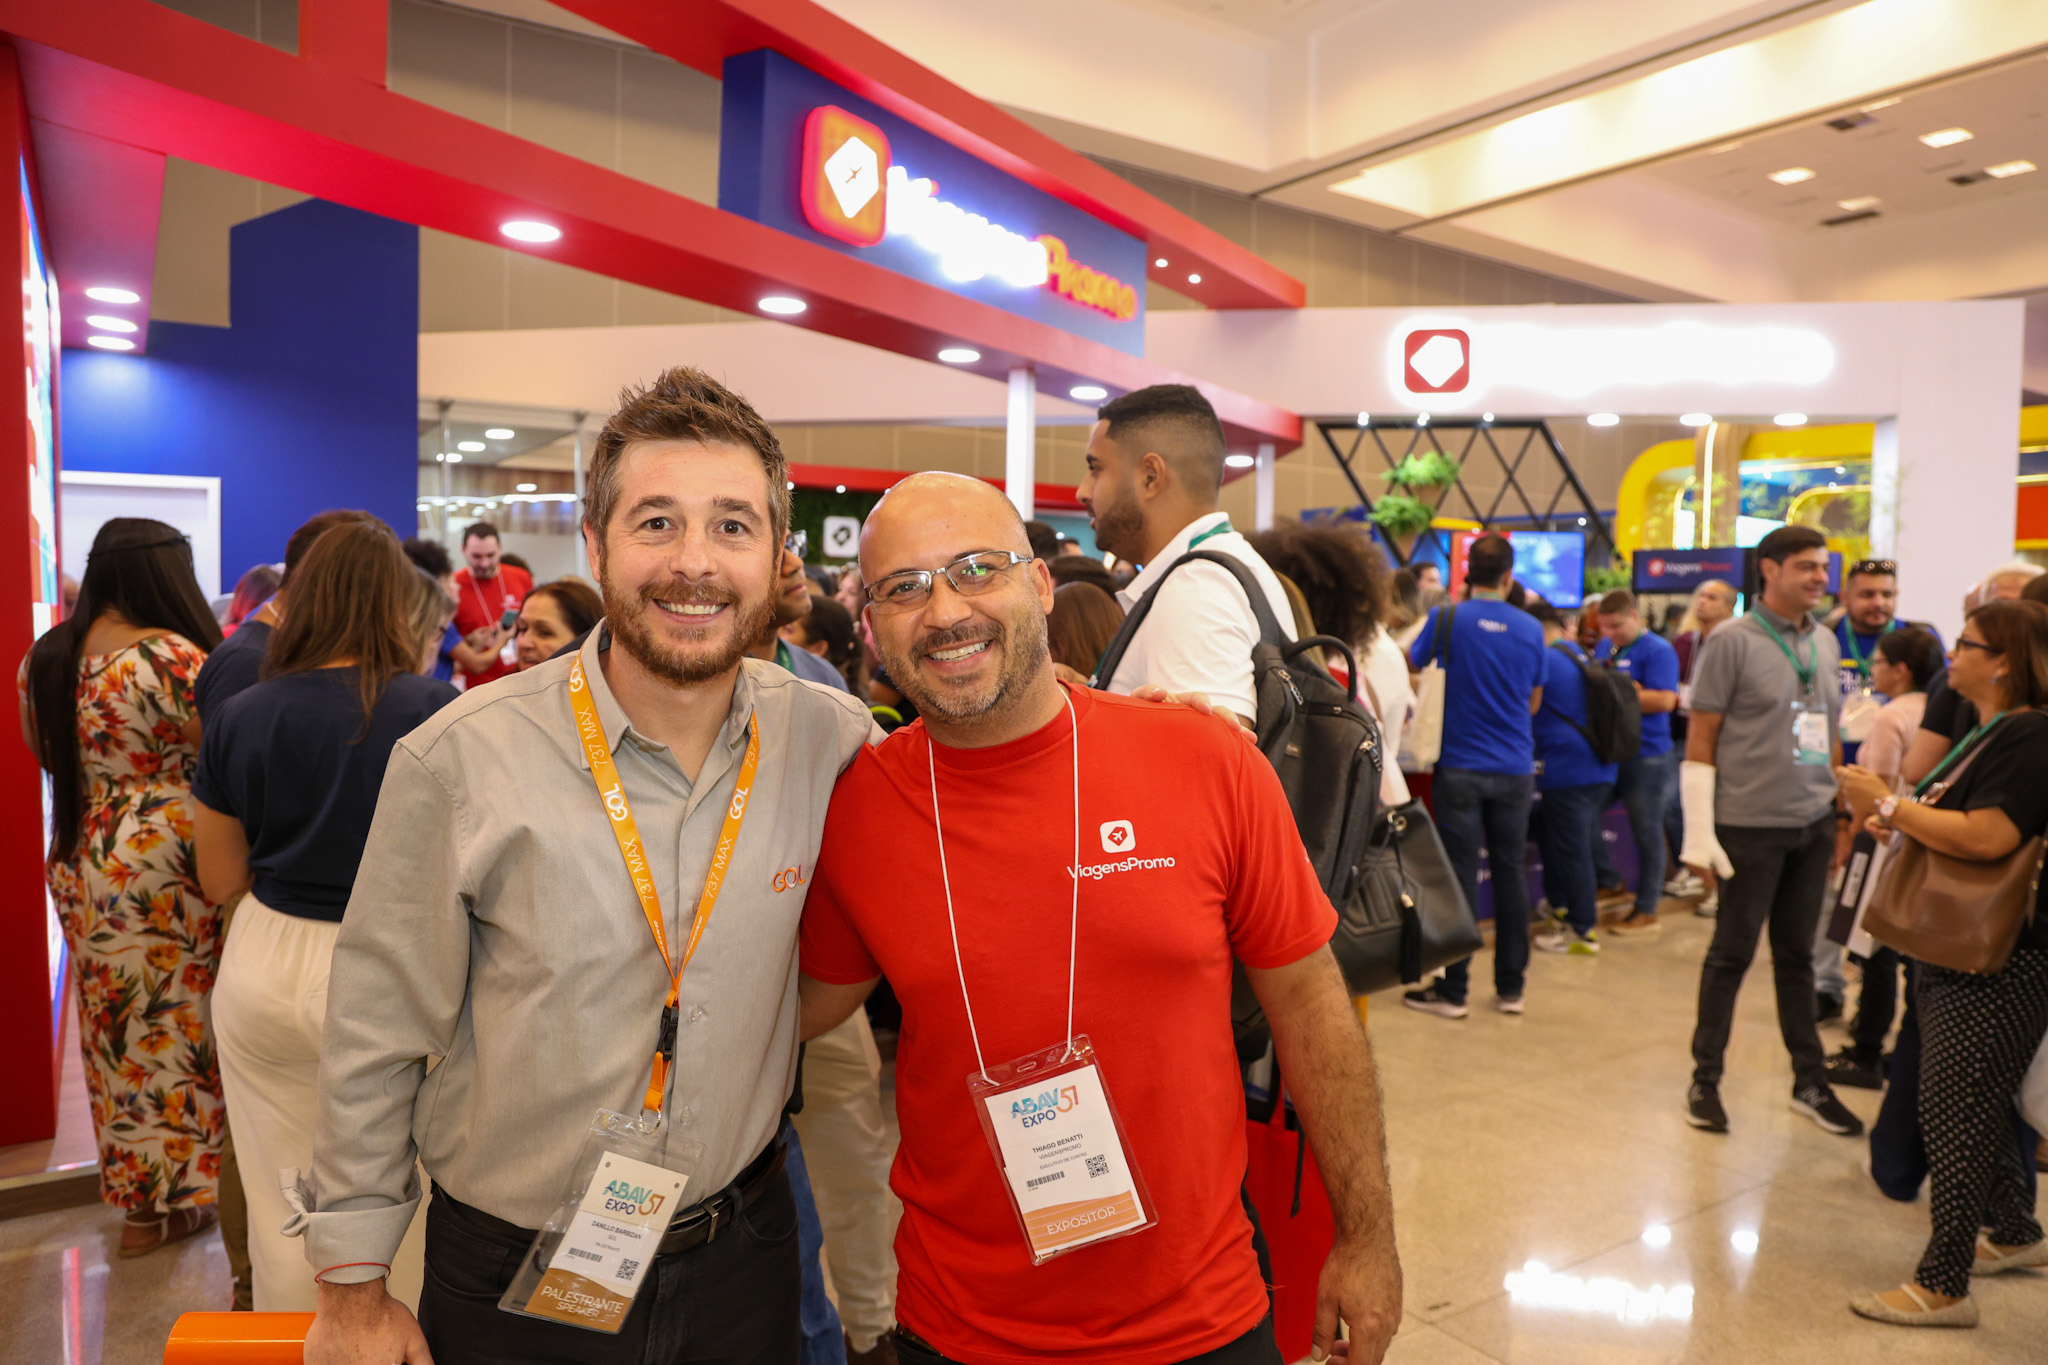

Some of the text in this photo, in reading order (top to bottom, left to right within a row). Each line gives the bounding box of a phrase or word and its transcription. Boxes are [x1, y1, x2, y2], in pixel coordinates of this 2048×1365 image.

[578, 706, 608, 769] 737 MAX
[603, 783, 628, 821] GOL
[730, 786, 748, 819] GOL
[624, 837, 654, 903] 737 MAX
[705, 836, 733, 899] 737 MAX
[772, 864, 806, 892] GOL
[1066, 857, 1176, 880] ViagensPromo
[1011, 1088, 1059, 1119] ABAV
[1022, 1109, 1056, 1128] EXPO
[1032, 1133, 1083, 1154] THIAGO BENATTI
[1039, 1143, 1082, 1160] VIAGENSPROMO
[602, 1180, 653, 1205] ABAV
[605, 1198, 636, 1215] EXPO
[1046, 1206, 1117, 1235] EXPOSITOR
[541, 1285, 624, 1314] PALESTRANTE
[556, 1301, 600, 1319] SPEAKER
